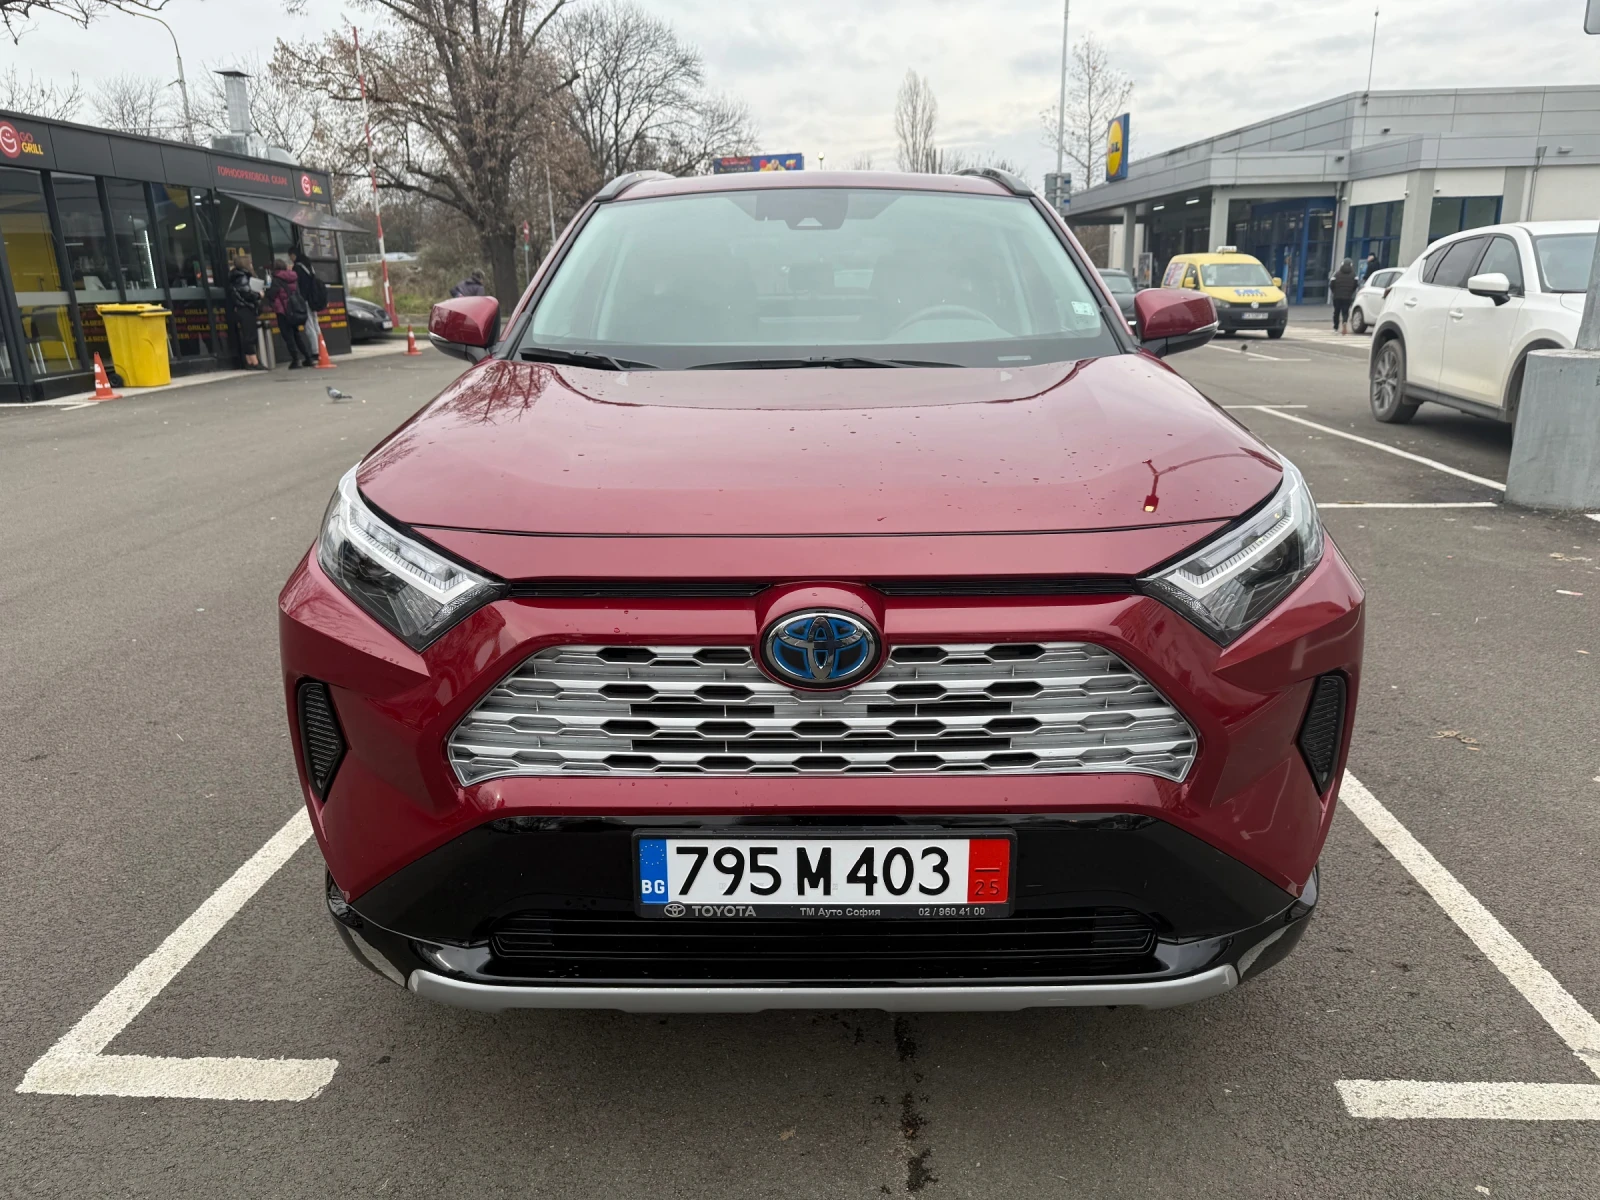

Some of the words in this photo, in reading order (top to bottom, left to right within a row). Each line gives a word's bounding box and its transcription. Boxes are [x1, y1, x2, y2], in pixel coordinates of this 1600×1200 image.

[22, 142, 44, 155] GRILL
[676, 846, 782, 896] 795
[796, 846, 832, 896] M
[846, 846, 951, 897] 403
[641, 879, 665, 894] BG
[974, 879, 1000, 896] 25
[691, 905, 757, 917] TOYOTA
[817, 907, 843, 918] Ауто
[845, 907, 881, 918] София
[918, 907, 930, 916] 02
[938, 907, 957, 916] 960
[959, 907, 971, 916] 41
[973, 907, 986, 916] 00
